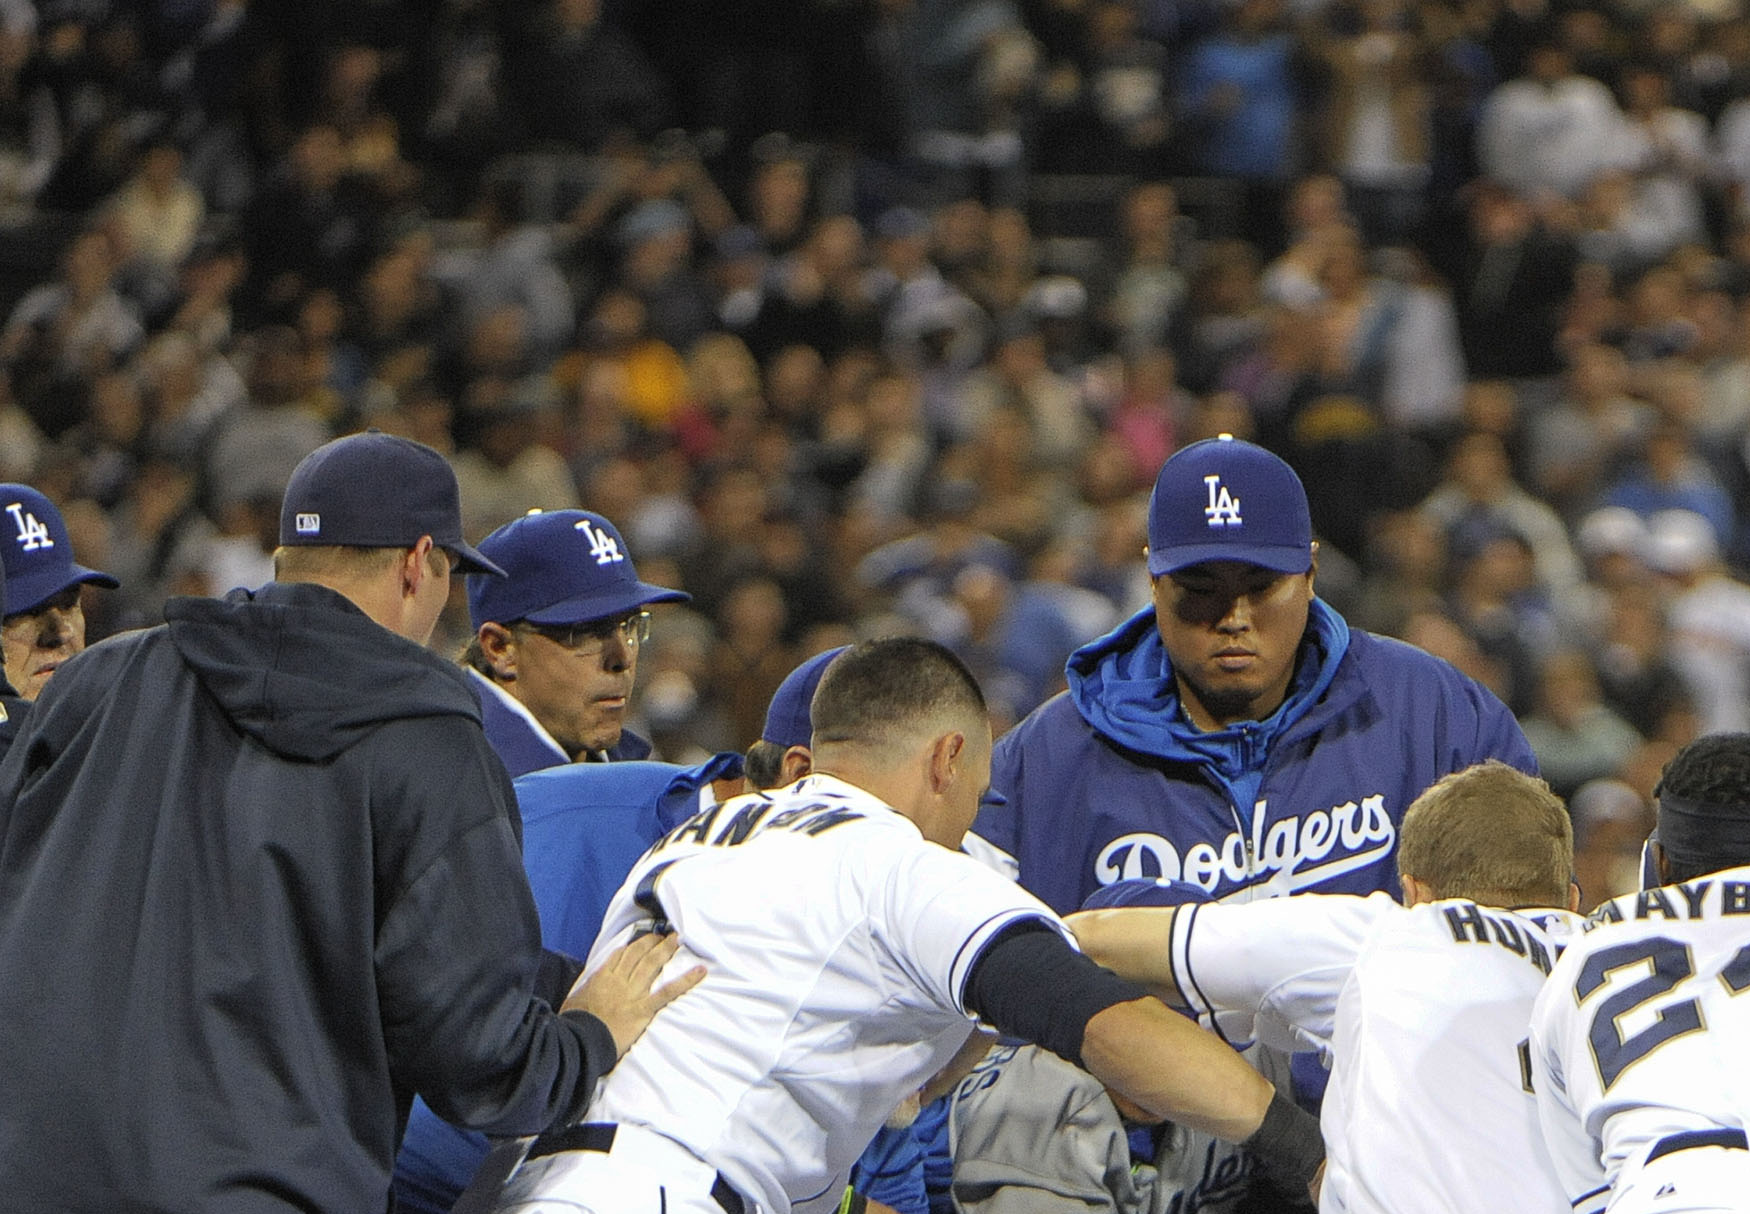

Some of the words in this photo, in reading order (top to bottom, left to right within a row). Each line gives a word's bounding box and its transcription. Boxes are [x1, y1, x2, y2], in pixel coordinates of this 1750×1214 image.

[1204, 475, 1243, 527] LA
[5, 502, 54, 551] LA
[574, 519, 624, 565] LA
[1094, 793, 1397, 898] Dodgers
